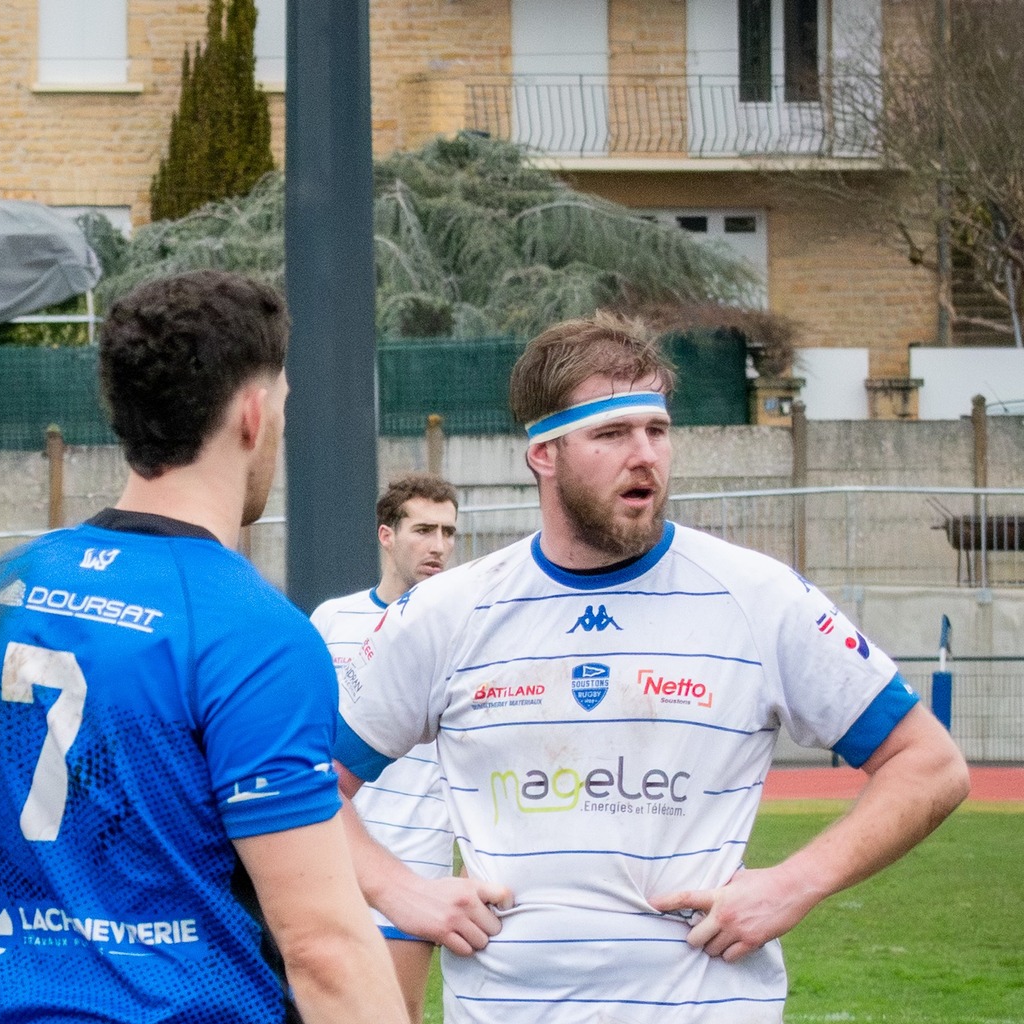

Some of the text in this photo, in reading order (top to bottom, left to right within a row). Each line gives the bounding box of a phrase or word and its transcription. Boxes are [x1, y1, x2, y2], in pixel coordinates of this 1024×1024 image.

[27, 586, 164, 626] DOURSAT
[571, 680, 609, 688] SOUSTONS
[643, 676, 706, 698] Netto
[660, 697, 691, 705] Soustons
[1, 641, 87, 841] 7
[491, 756, 690, 826] magelec
[635, 806, 644, 815] et
